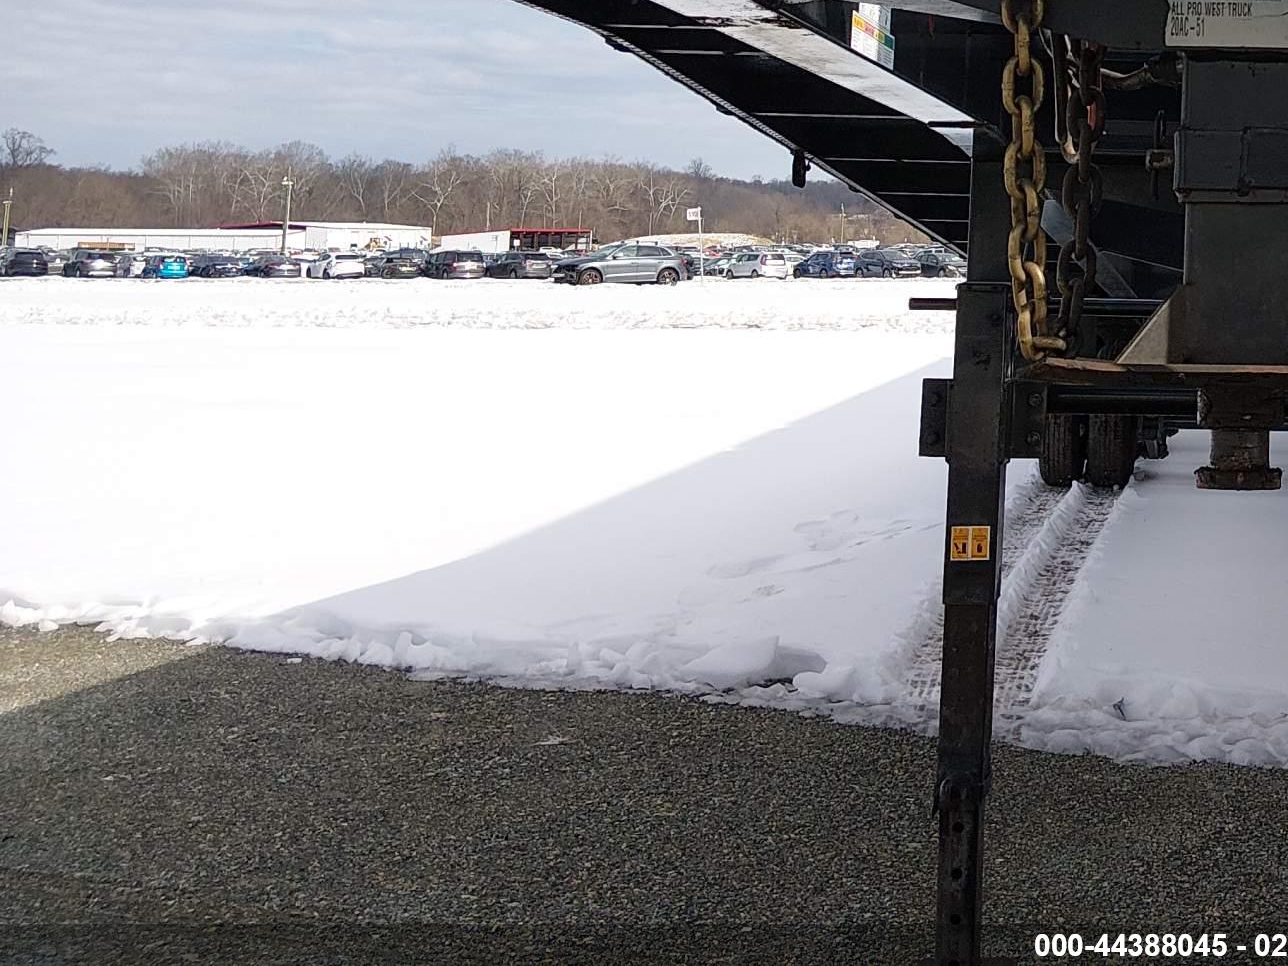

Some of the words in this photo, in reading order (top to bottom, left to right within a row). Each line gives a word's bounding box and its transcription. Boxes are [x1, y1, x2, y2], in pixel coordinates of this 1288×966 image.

[1171, 1, 1184, 15] ALL
[1187, 1, 1202, 16] PRO
[1204, 2, 1226, 16] WEST
[1228, 2, 1253, 17] TRUCK
[1170, 17, 1205, 37] 20AC-51
